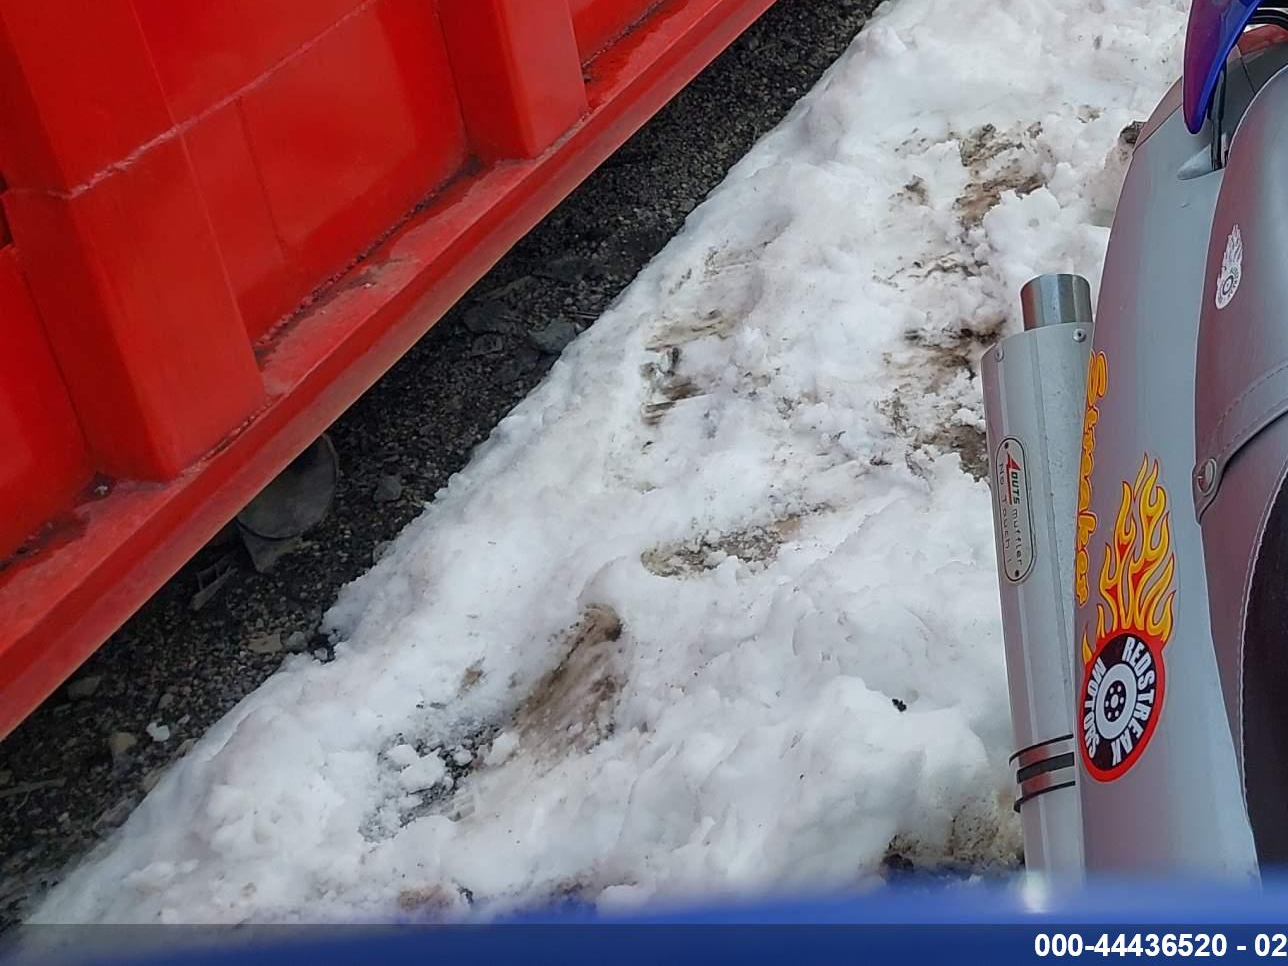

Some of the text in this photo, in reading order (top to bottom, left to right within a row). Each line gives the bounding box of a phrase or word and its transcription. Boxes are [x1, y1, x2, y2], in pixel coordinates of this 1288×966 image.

[1011, 508, 1022, 566] muffler
[1083, 656, 1107, 759] MOTORS
[1111, 636, 1155, 766] REDSTREAK
